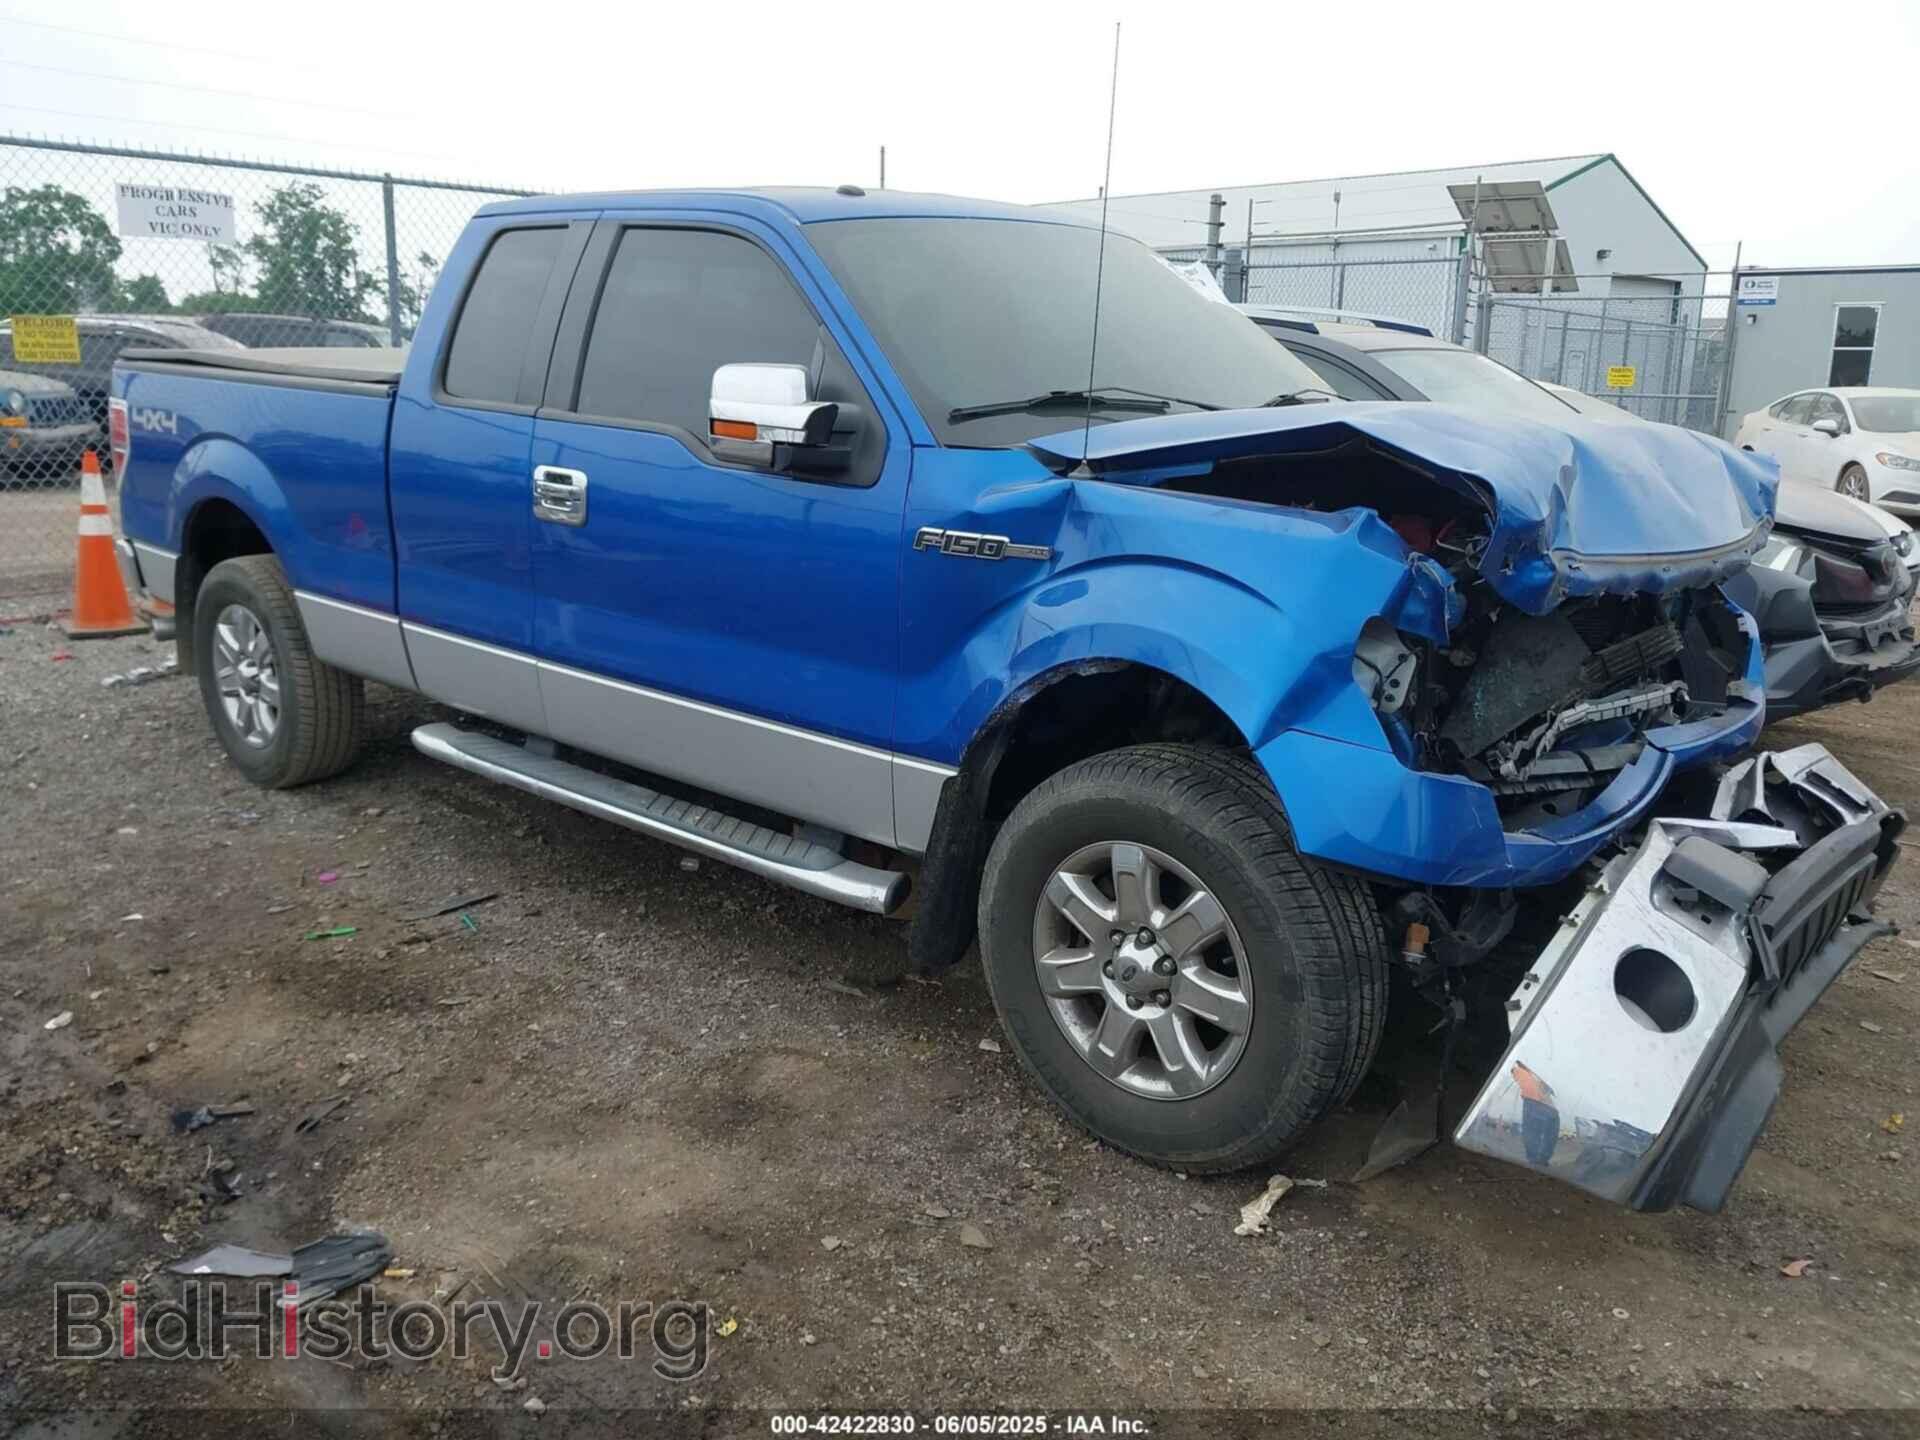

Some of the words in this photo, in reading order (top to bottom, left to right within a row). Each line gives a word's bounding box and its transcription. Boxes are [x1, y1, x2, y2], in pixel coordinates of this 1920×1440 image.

[120, 185, 233, 208] PROGRESSIVE
[155, 205, 198, 218] CARS
[148, 221, 177, 234] VIC
[181, 222, 222, 237] ONLY
[913, 526, 1011, 560] F-150
